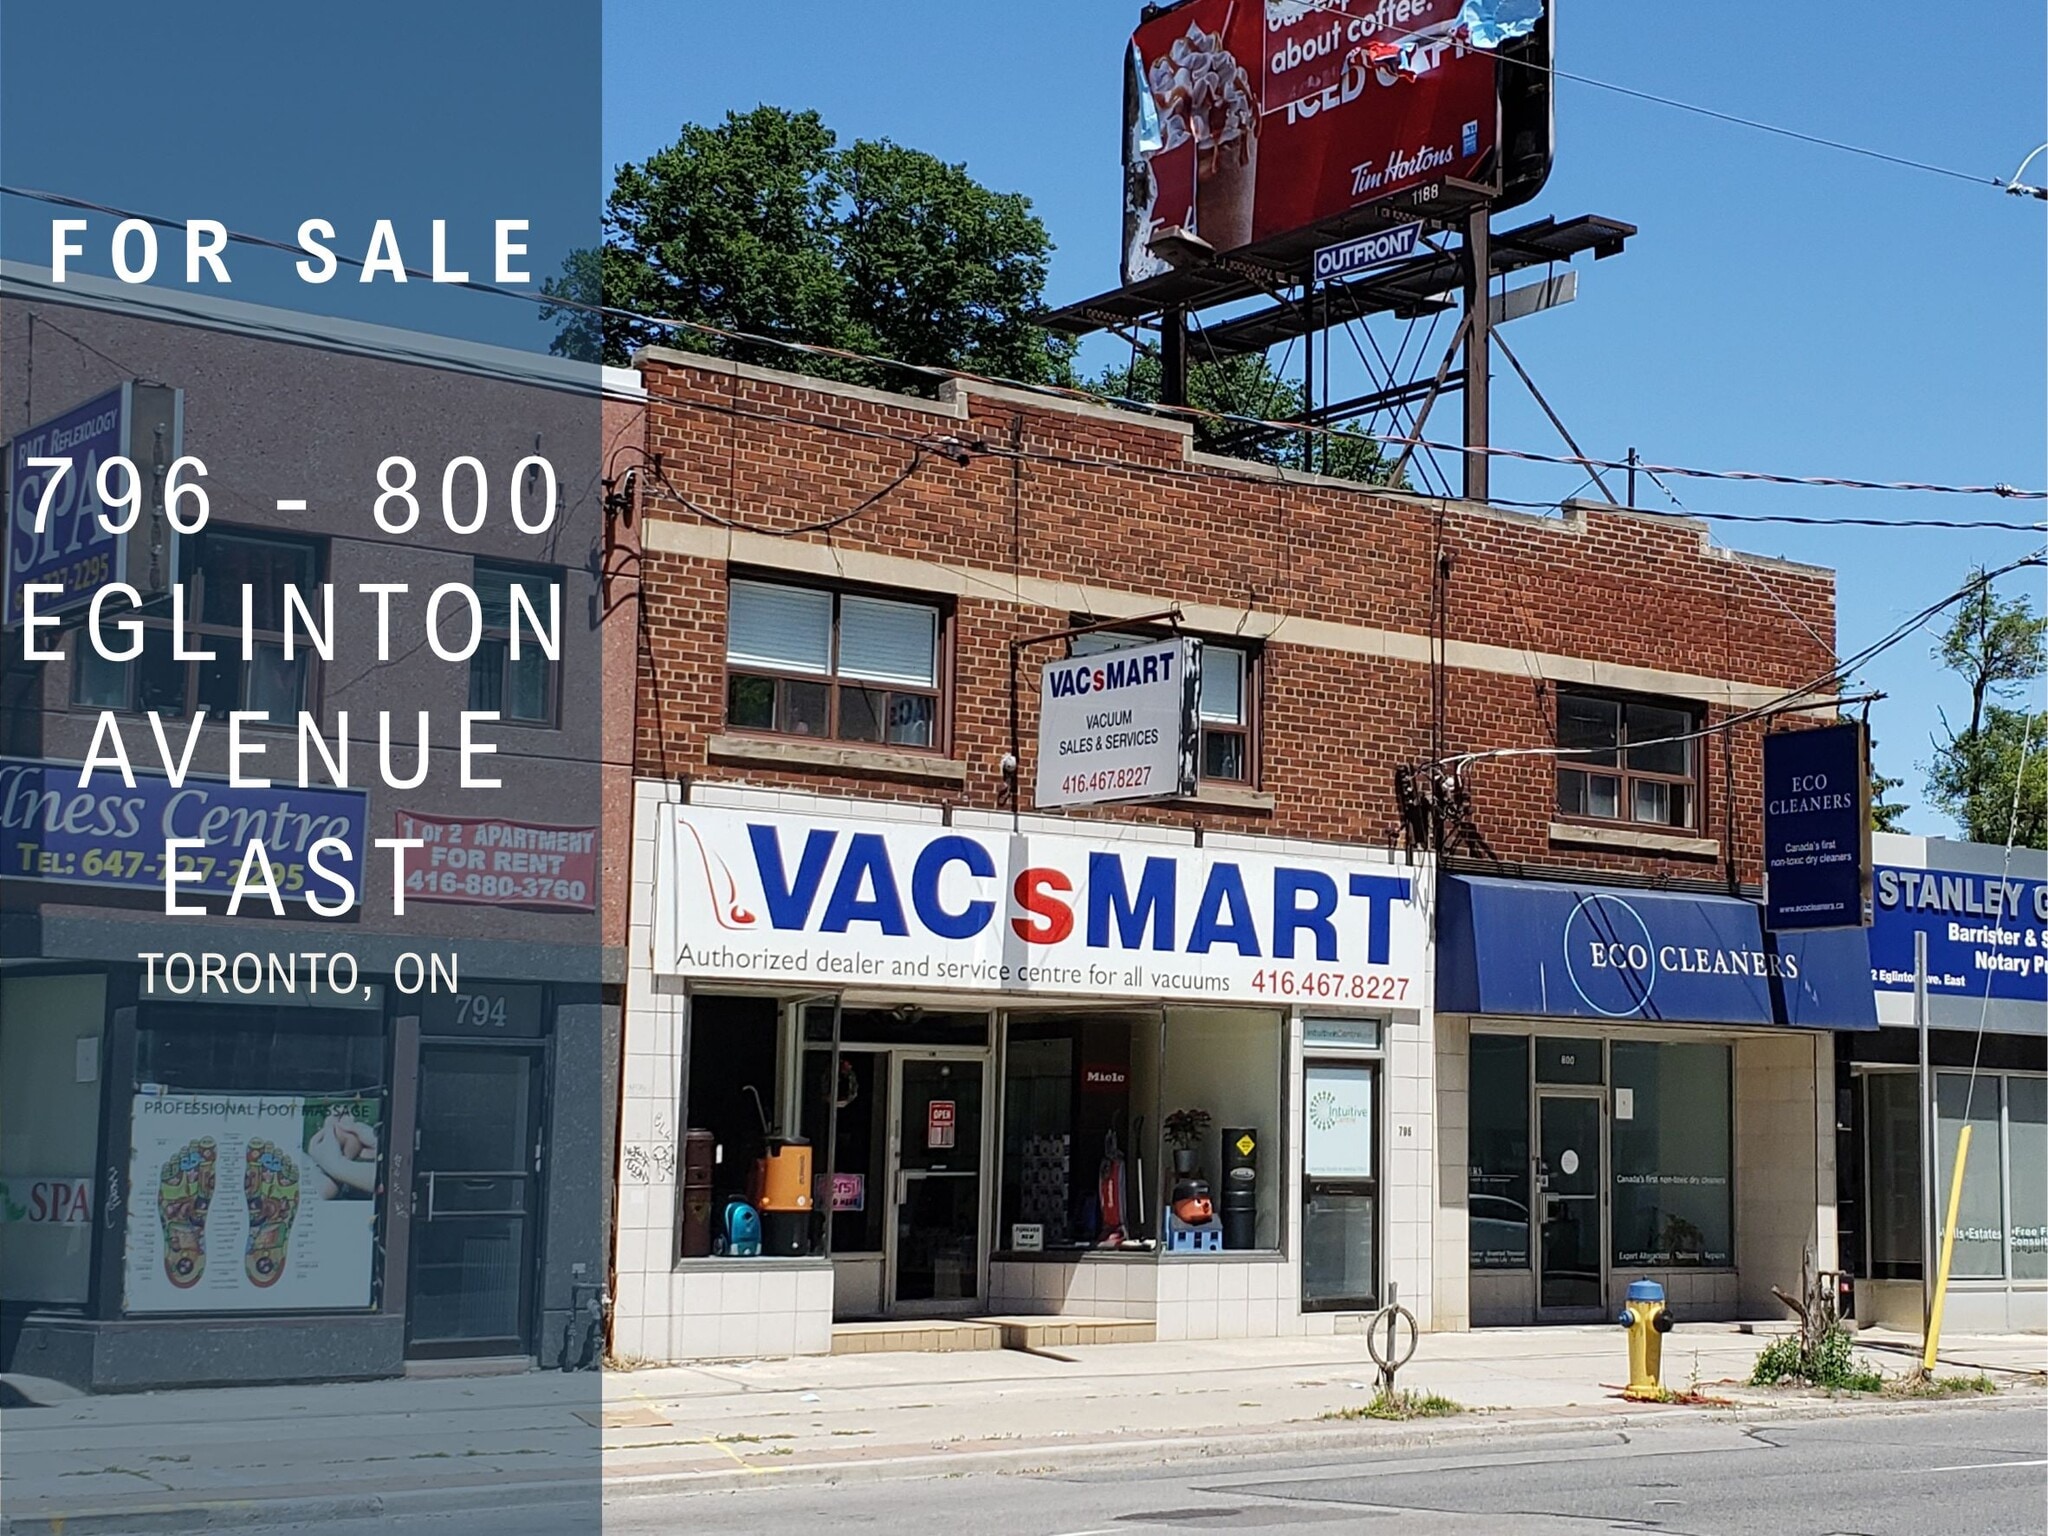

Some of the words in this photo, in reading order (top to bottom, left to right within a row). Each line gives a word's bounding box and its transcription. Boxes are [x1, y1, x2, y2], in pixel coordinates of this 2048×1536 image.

[1271, 20, 1342, 74] about
[1347, 0, 1433, 43] coffee.
[1351, 160, 1382, 196] Tim
[1384, 145, 1454, 184] Hortons
[1411, 184, 1439, 205] 1188
[1318, 229, 1413, 273] OUTFRONT
[14, 449, 113, 573] SPA
[1086, 709, 1132, 729] VACUUM
[1060, 737, 1093, 756] SALES
[1096, 735, 1102, 750] &
[1105, 729, 1159, 750] SERVICES
[1062, 766, 1152, 794] 416.467.8227
[1792, 774, 1828, 793] ECO
[1769, 793, 1852, 815] CLEANERS
[161, 789, 350, 855] Centre
[403, 818, 414, 840] 1
[422, 824, 444, 842] or
[448, 824, 464, 844] 2
[474, 825, 595, 854] APARTMENT
[1785, 840, 1820, 853] Canada's
[1821, 839, 1836, 851] first
[82, 848, 305, 892] 647-727-2295
[431, 846, 487, 871] FOR
[493, 851, 567, 875] RENT
[1771, 856, 1804, 867] non-toxic
[1805, 854, 1818, 866] dry
[1820, 852, 1852, 864] cleaners
[405, 869, 586, 901] 416-880-3760
[1878, 869, 2025, 917] STANLEY
[1948, 922, 2021, 946] Barrister
[2025, 929, 2037, 947] &
[675, 943, 808, 971] Authorized
[817, 949, 885, 977] dealer
[892, 954, 930, 978] and
[936, 959, 1010, 981] service
[1018, 964, 1082, 984] centre
[1088, 963, 1118, 986] for
[1124, 965, 1143, 988] all
[1151, 973, 1231, 992] vacuums
[1589, 942, 1648, 971] ECO
[1660, 946, 1799, 979] CLEANERS
[1975, 950, 2030, 977] Notary
[1251, 969, 1410, 1001] 416.467.8227
[1880, 970, 1916, 984] Eglinto
[1943, 974, 1966, 987] East
[455, 994, 507, 1027] 794
[1561, 1055, 1575, 1065] 800
[1087, 1071, 1125, 1083] Miele
[144, 1101, 255, 1117] PROFESSIONAL
[258, 1101, 297, 1117] FOOT
[933, 1109, 951, 1120] OPEN
[1328, 1105, 1368, 1118] Intuitive
[28, 1182, 93, 1222] SPA
[1968, 1227, 2002, 1240] Estates
